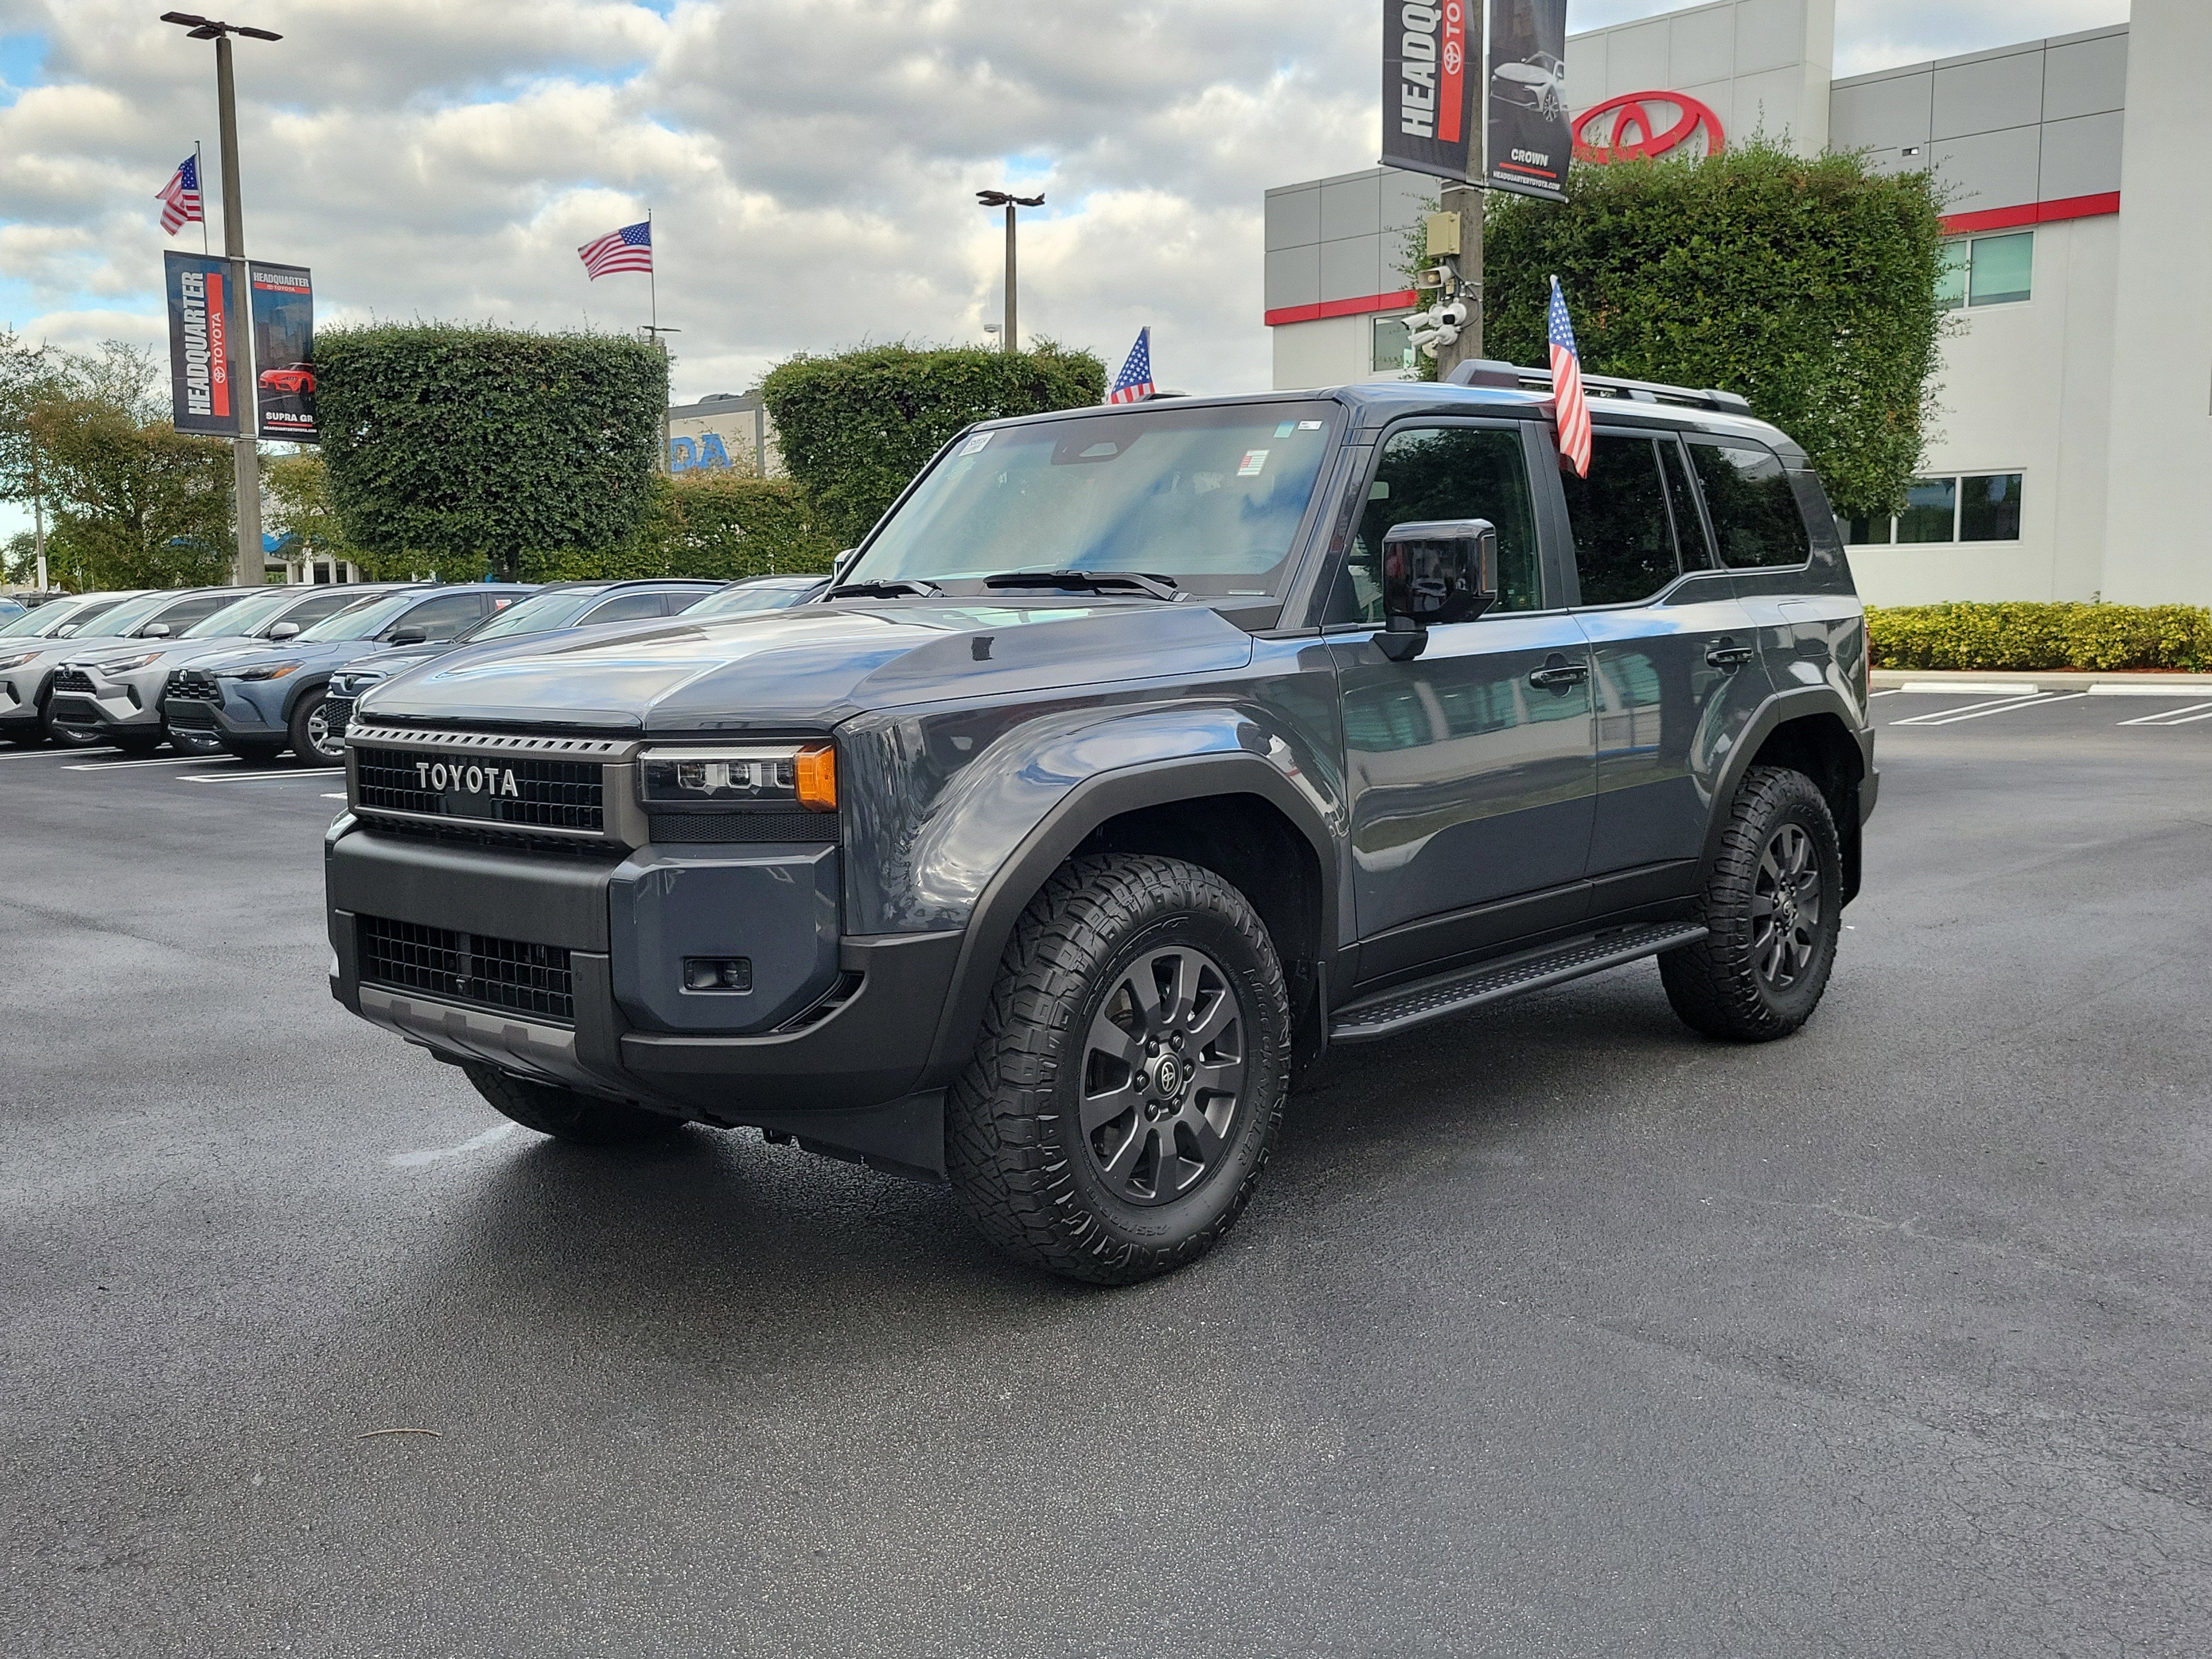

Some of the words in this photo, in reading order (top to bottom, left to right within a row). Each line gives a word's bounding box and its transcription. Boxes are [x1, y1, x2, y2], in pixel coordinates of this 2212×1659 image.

[1446, 0, 1461, 38] TO
[1402, 0, 1442, 138] HEADQ
[1511, 148, 1549, 167] CROWN
[253, 272, 309, 287] HEADQUARTER
[182, 272, 211, 415] HEADQUARTER
[212, 312, 223, 365] TOYOTA
[266, 412, 298, 422] SUPRA
[300, 414, 313, 422] GR
[670, 433, 733, 473] DA
[416, 763, 518, 797] TOYOTA
